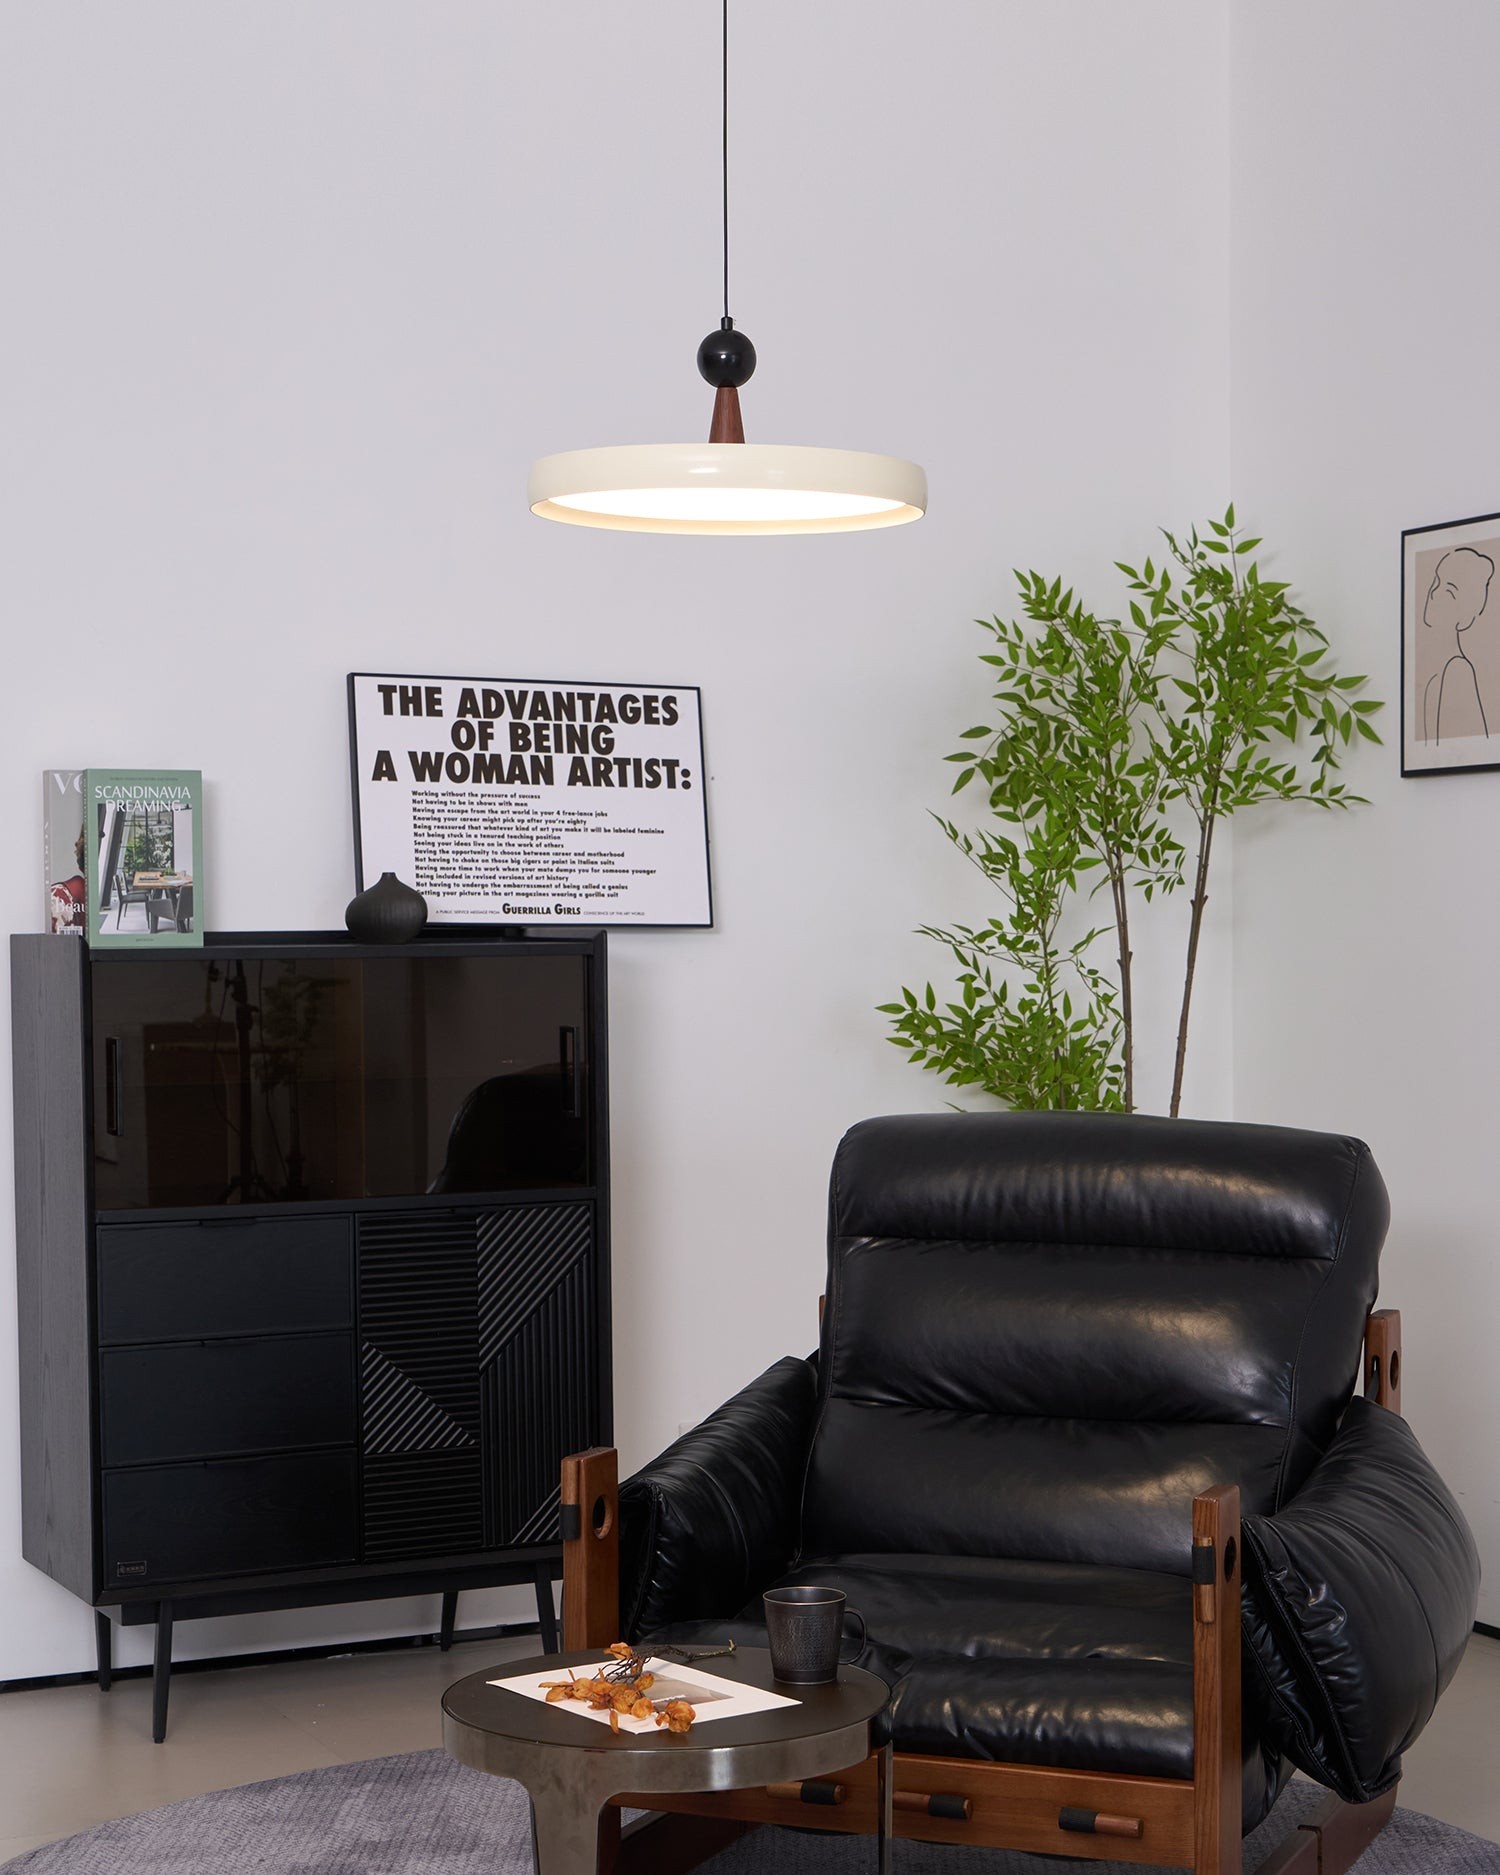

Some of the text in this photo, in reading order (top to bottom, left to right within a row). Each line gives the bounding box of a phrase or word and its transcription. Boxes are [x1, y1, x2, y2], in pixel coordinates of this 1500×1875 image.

[378, 684, 679, 727] THE ADVANTAGES
[450, 719, 615, 756] OF BEING
[371, 750, 692, 790] A WOMAN ARTIST:
[94, 785, 192, 799] SCANDINAVIA
[105, 799, 182, 813] DREAMING
[502, 902, 552, 916] GUERRILLA
[554, 904, 581, 916] GIRLS
